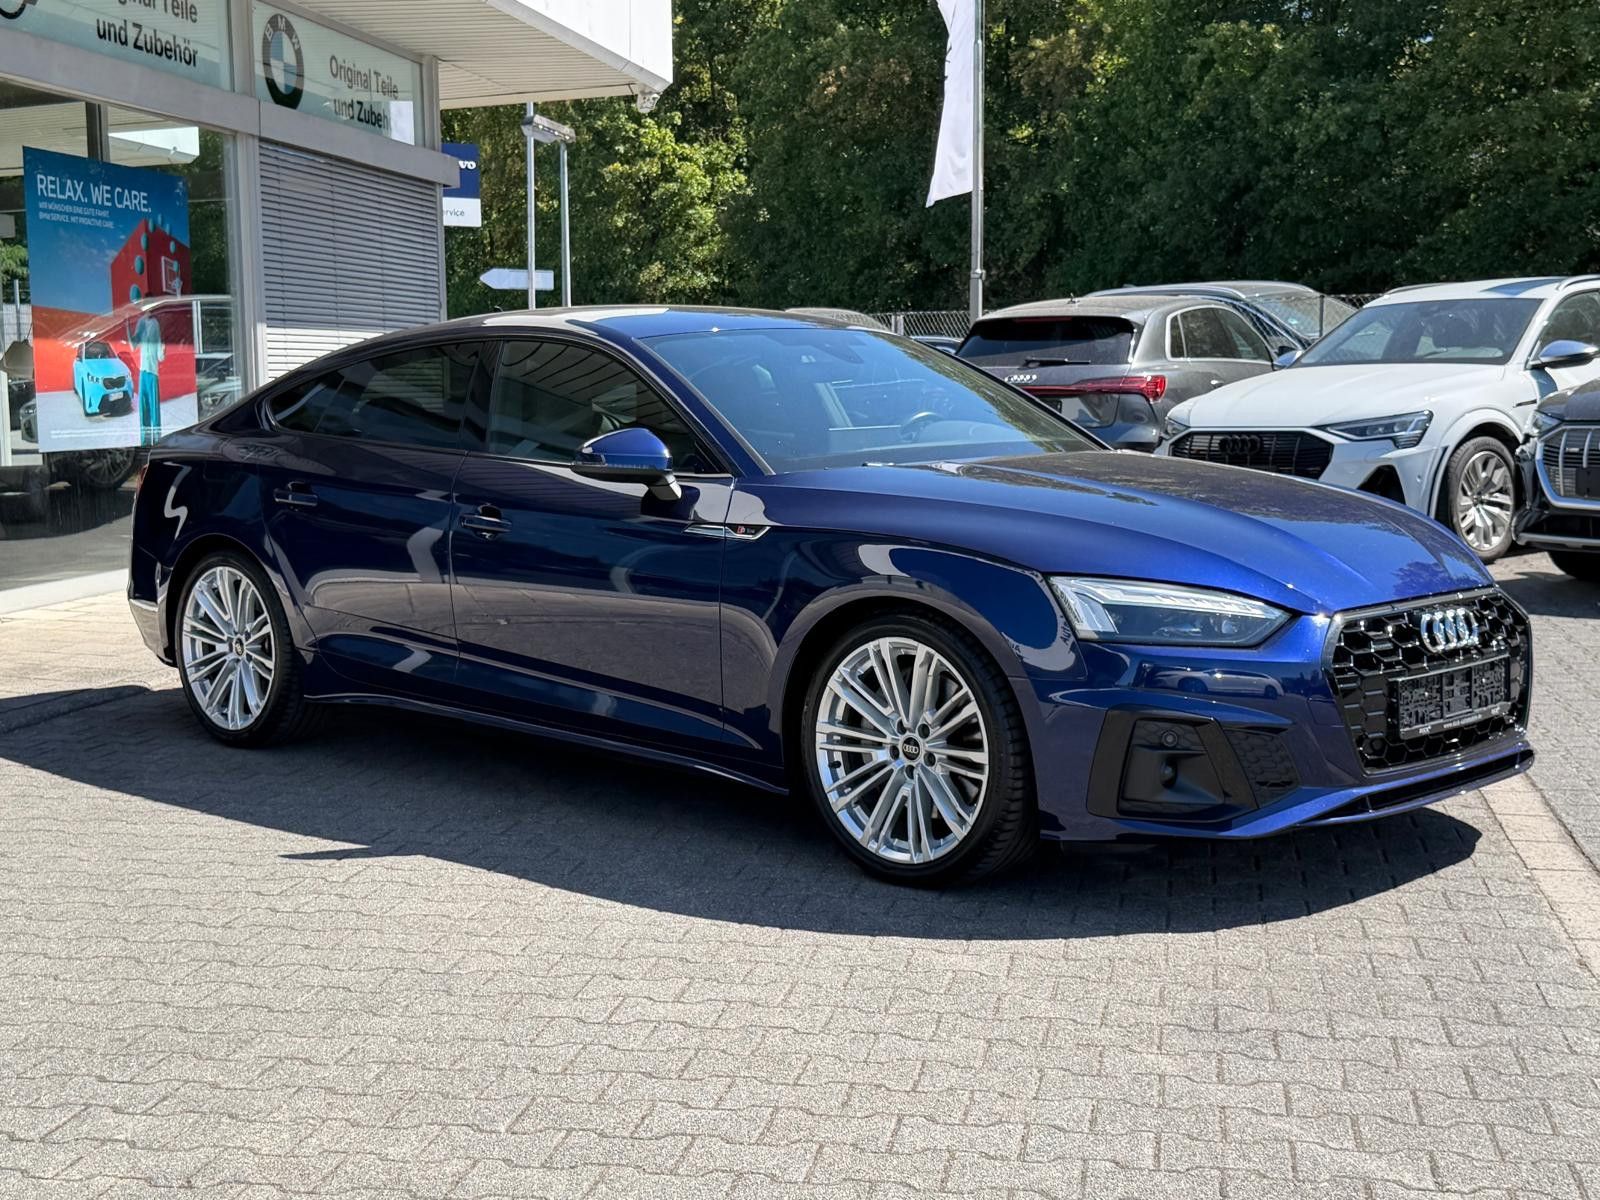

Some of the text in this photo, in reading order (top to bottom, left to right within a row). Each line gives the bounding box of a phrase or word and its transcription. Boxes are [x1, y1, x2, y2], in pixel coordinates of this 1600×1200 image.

[96, 18, 198, 67] und Zubehör
[264, 15, 301, 50] BMW
[329, 54, 399, 99] Original Teile
[333, 98, 391, 131] und Zubeh
[458, 160, 477, 170] vo
[37, 174, 152, 213] RELAX. WE CARE.
[443, 207, 465, 217] rvice
